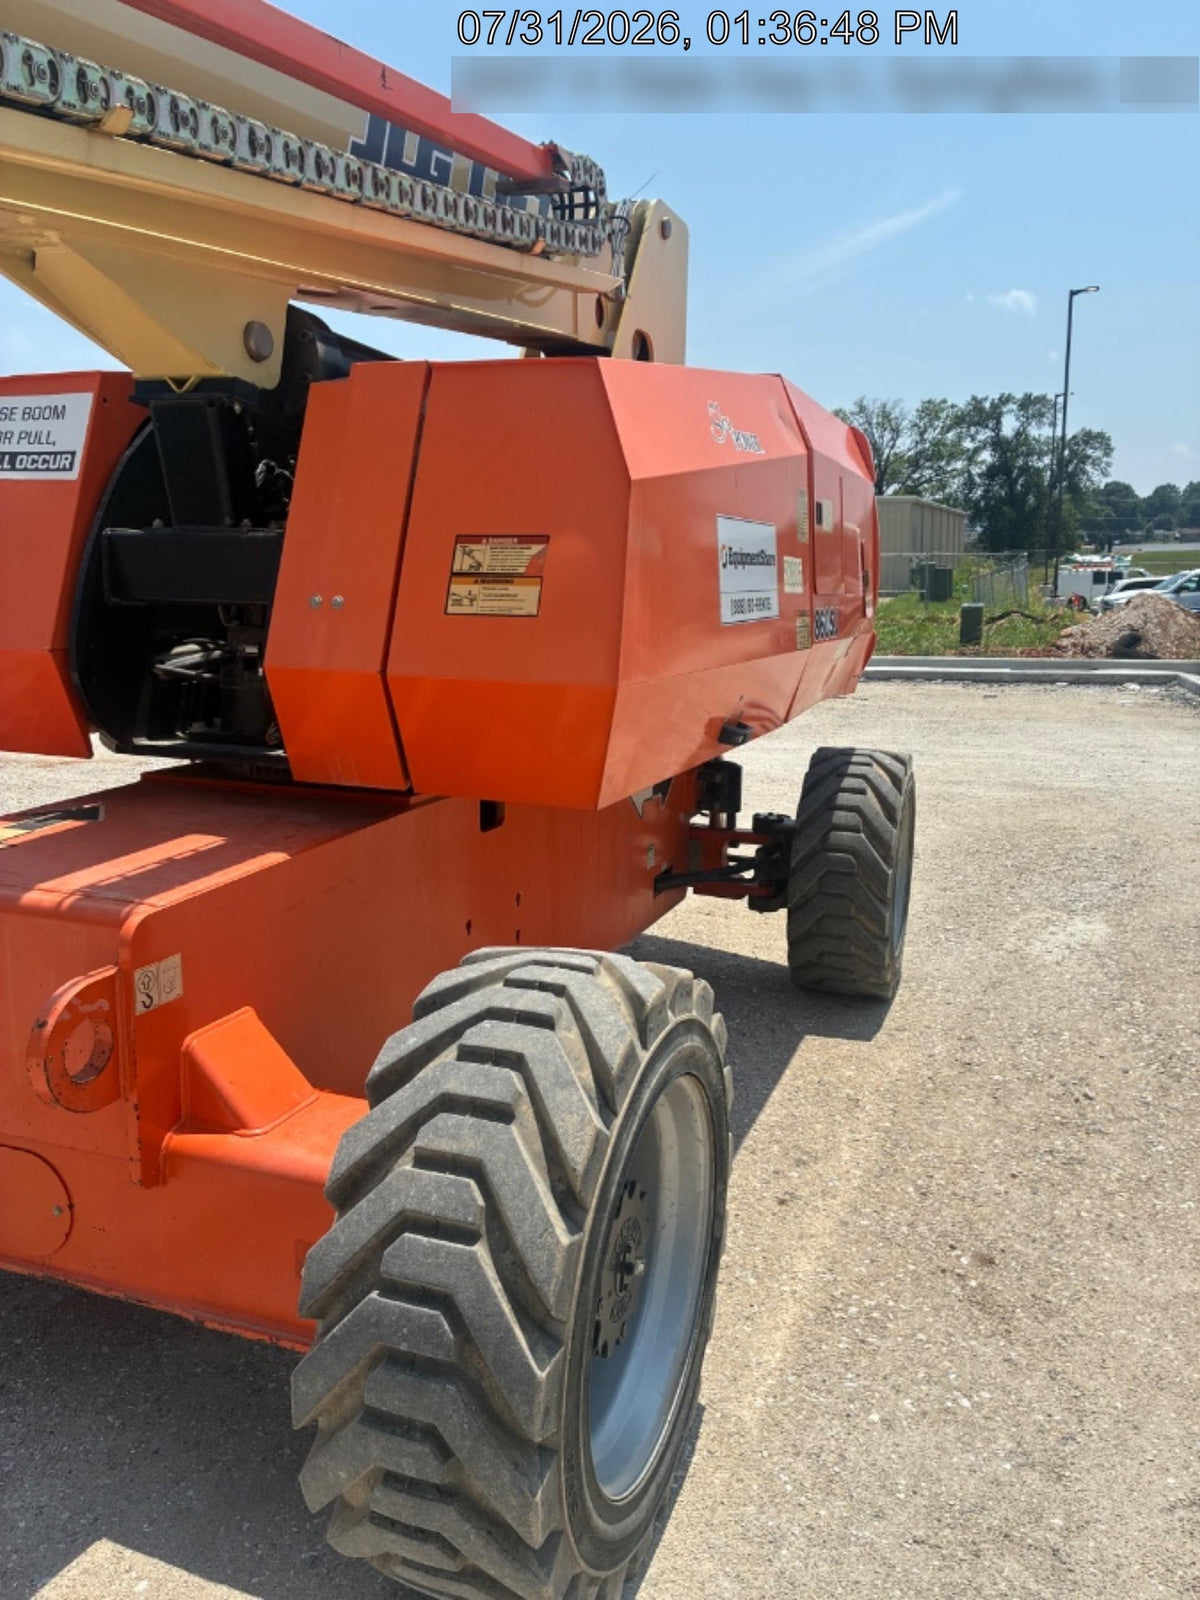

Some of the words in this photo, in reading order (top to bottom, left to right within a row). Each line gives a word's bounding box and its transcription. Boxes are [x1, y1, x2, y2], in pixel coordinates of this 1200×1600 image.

[21, 404, 66, 420] BOOM
[17, 430, 56, 447] PULL,
[15, 453, 73, 469] OCCUR
[728, 546, 776, 570] EquipmentShare
